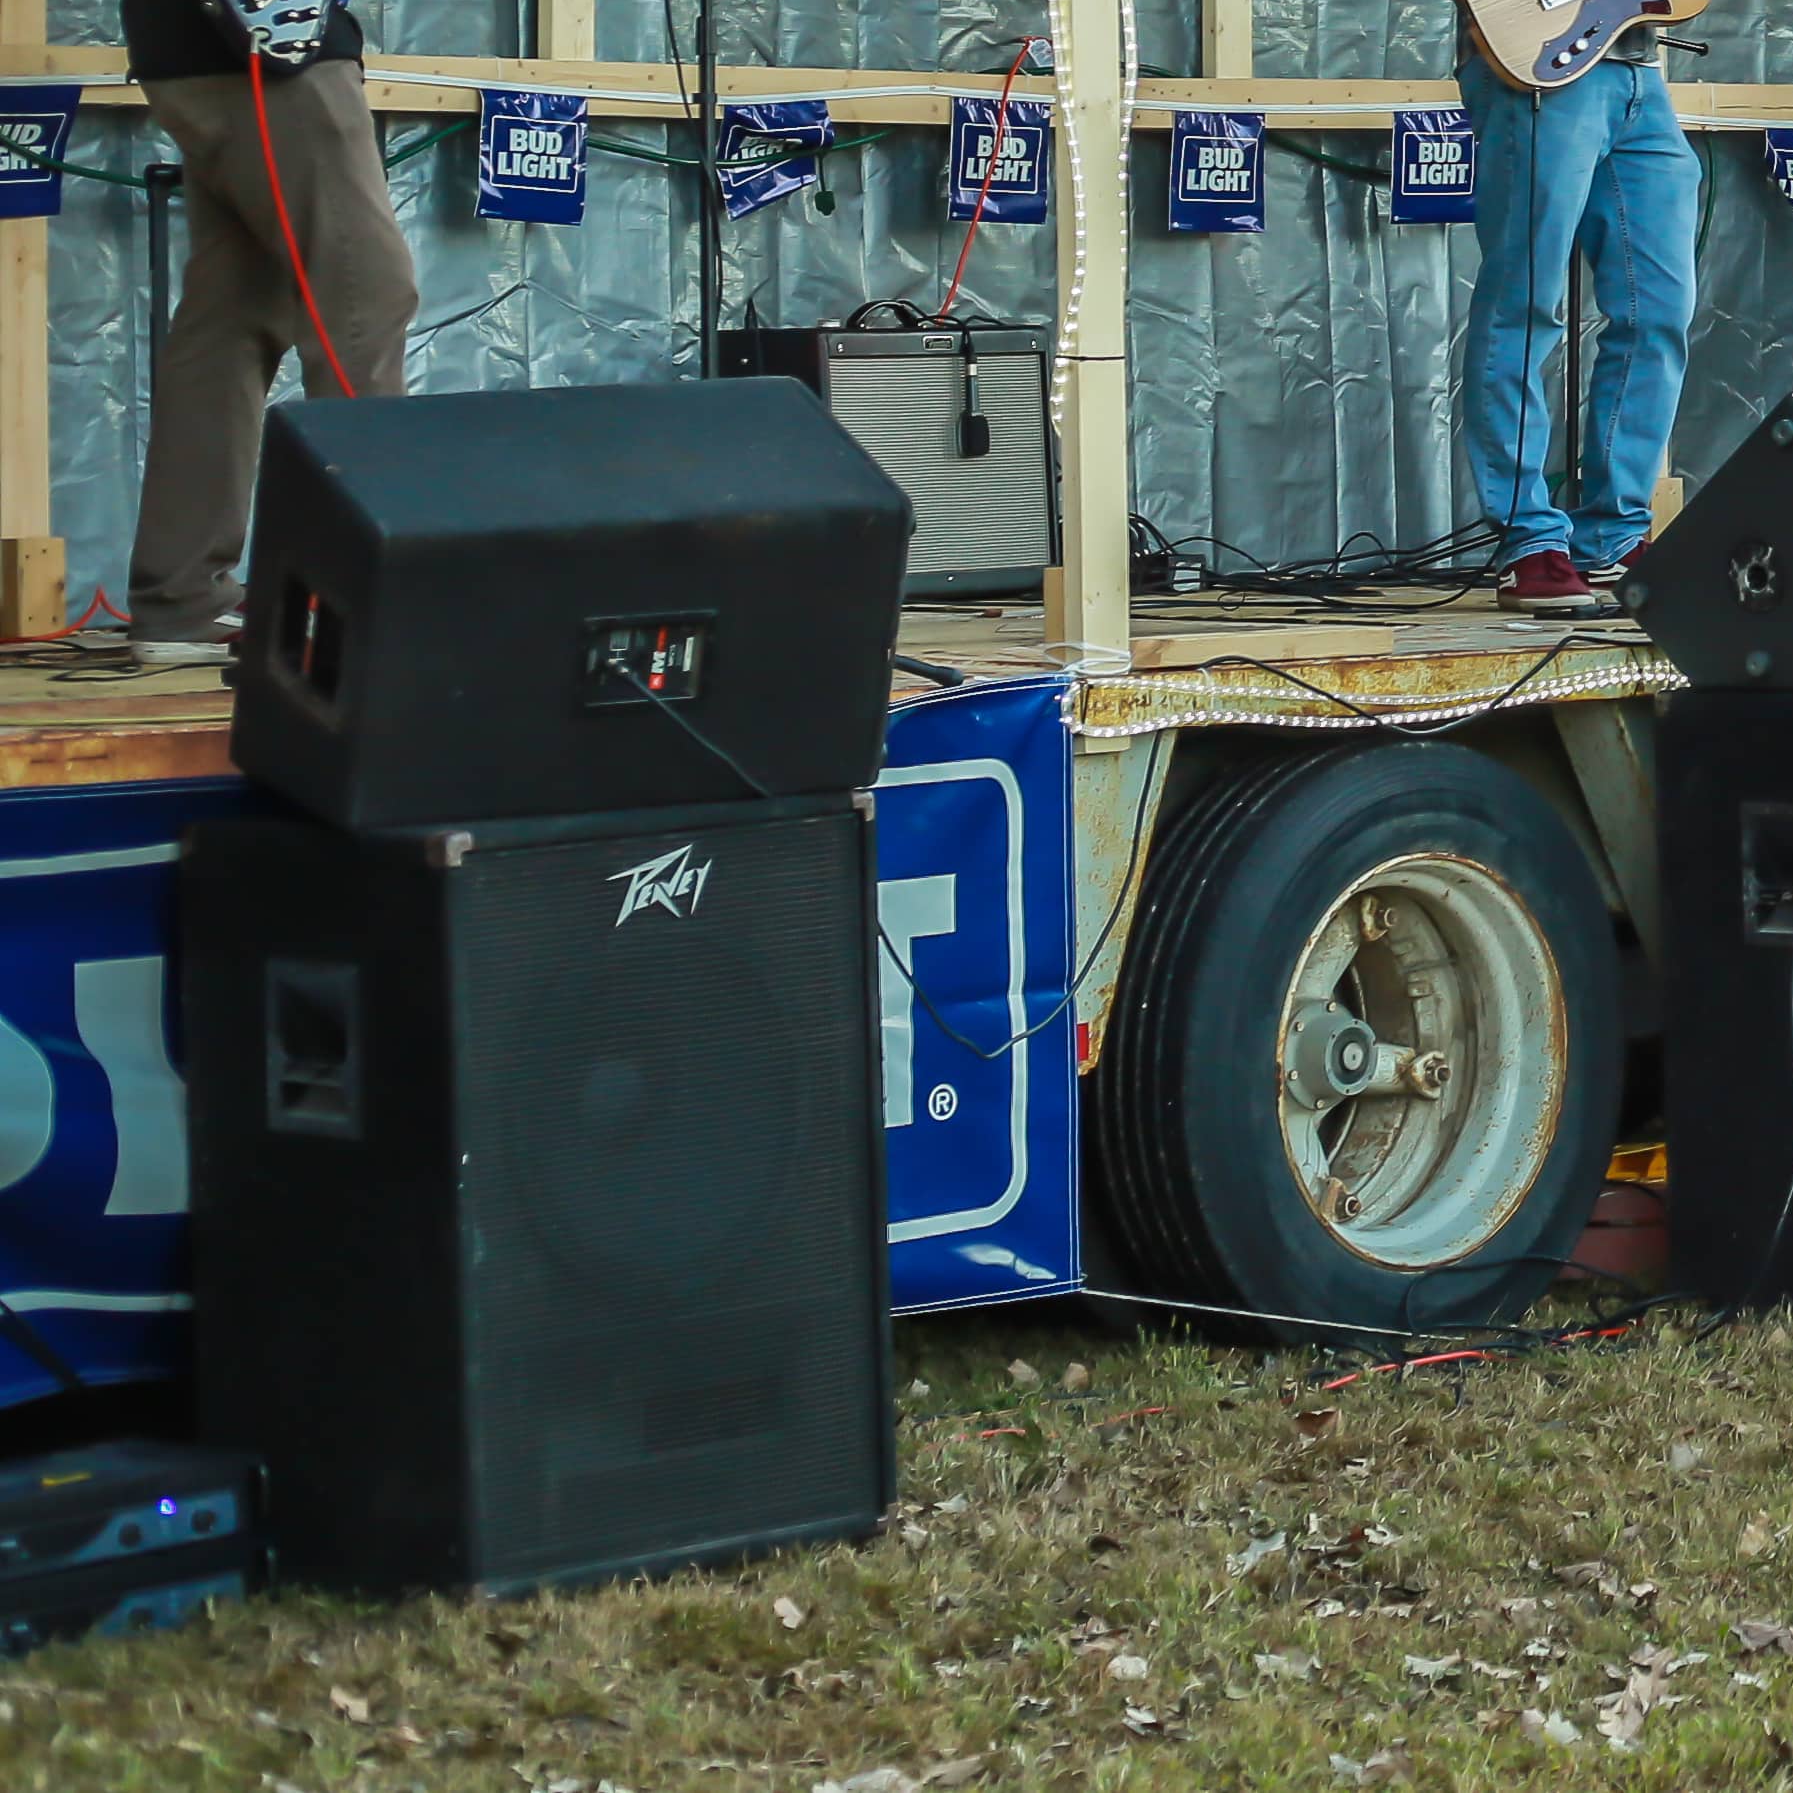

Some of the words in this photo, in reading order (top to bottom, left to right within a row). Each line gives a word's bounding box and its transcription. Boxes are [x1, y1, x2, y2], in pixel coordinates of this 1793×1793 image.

[509, 129, 563, 155] BUD
[977, 134, 1026, 161] BUD
[1418, 141, 1462, 164] BUD
[497, 152, 571, 180] LIGHT
[966, 153, 1033, 184] LIGHT
[1199, 147, 1245, 171] BUD
[1187, 166, 1250, 192] LIGHT
[1409, 161, 1468, 187] LIGHT
